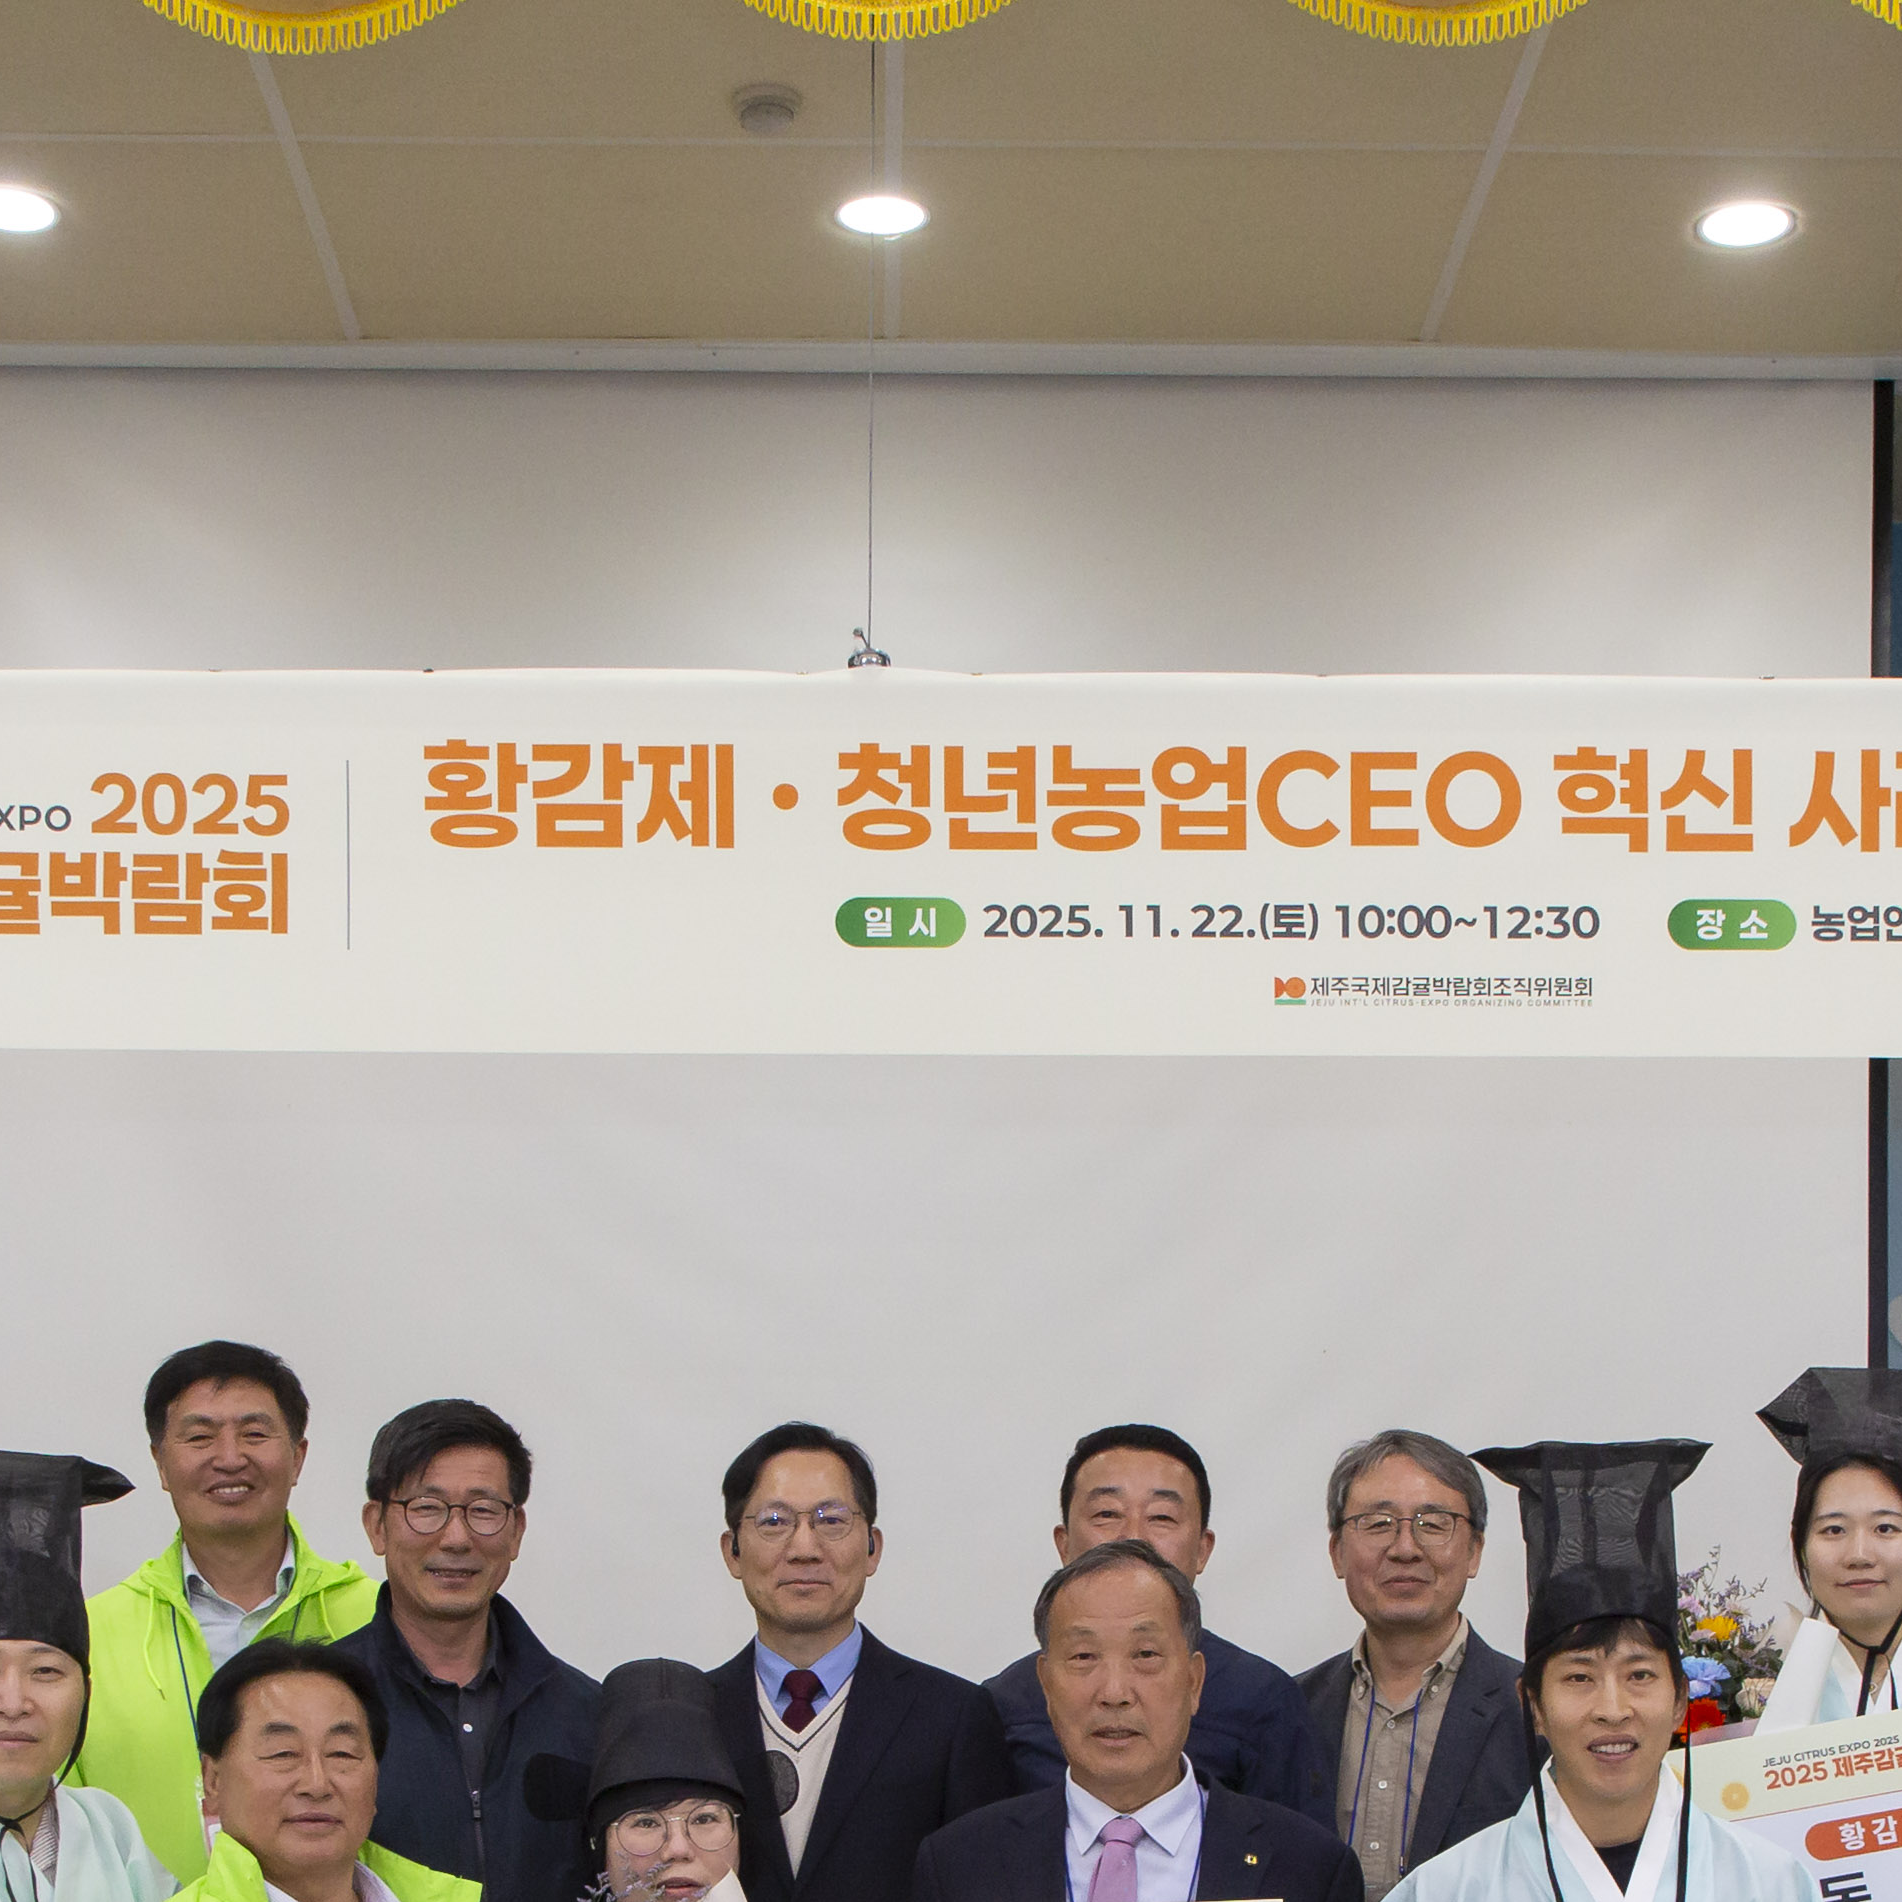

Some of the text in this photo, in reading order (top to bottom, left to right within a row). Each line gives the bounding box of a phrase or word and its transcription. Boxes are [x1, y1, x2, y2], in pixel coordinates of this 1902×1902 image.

[90, 771, 290, 837] 2025
[424, 738, 735, 850] 황감제
[836, 742, 1523, 852] 청년농업CEO
[1552, 746, 1755, 856] 혁신
[982, 903, 1104, 940] 2025.
[1118, 904, 1180, 940] 11.
[1335, 904, 1601, 941] 10:00~12:30
[1310, 976, 1593, 997] 제주국제감귤박람회조직위원회
[1311, 998, 1336, 1007] JEJU
[1454, 998, 1523, 1007] ORGANIZING
[1527, 998, 1594, 1007] COMMITTEE
[1762, 1735, 1900, 1768] JEJU CITRUS EXPO 2025
[1764, 1760, 1829, 1790] 2025
